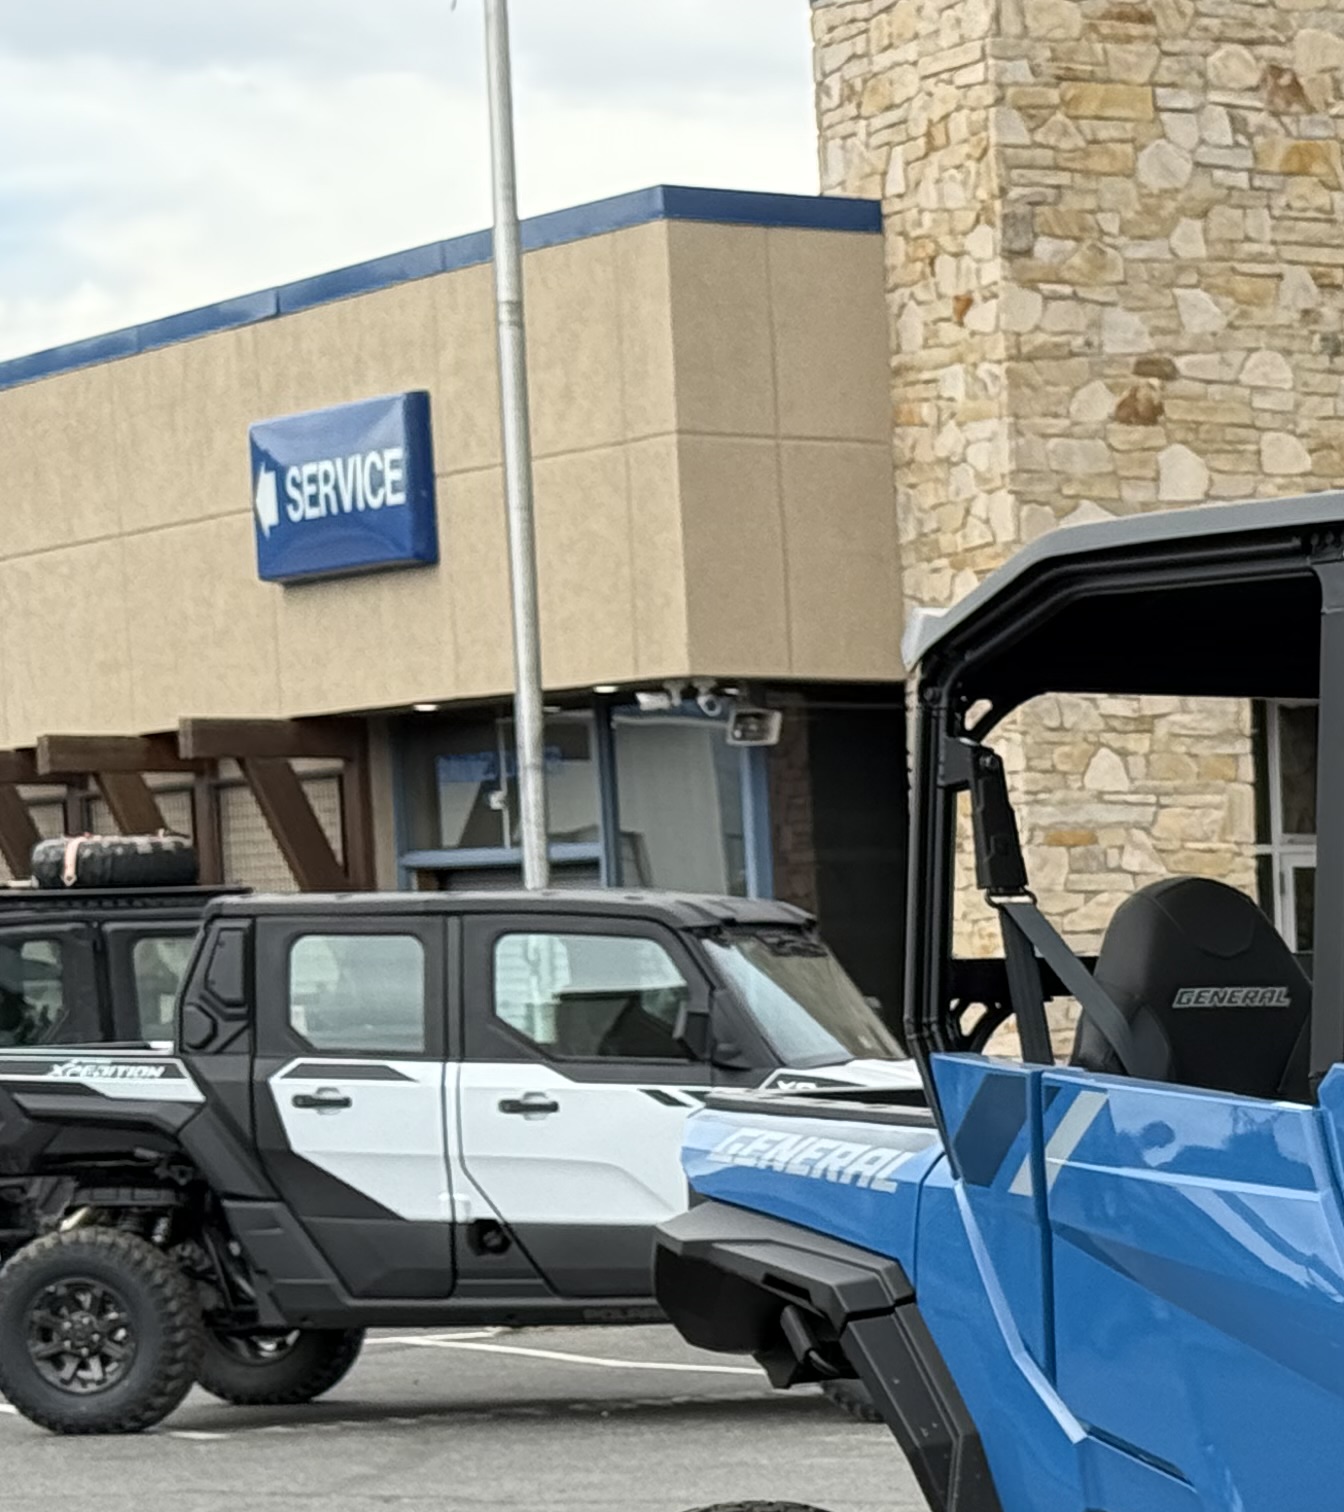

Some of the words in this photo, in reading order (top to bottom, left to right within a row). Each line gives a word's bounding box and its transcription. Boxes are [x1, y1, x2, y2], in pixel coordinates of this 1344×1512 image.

[286, 447, 406, 523] SERVICE
[1172, 986, 1292, 1009] GENERAL
[706, 1126, 915, 1195] GENERAL
